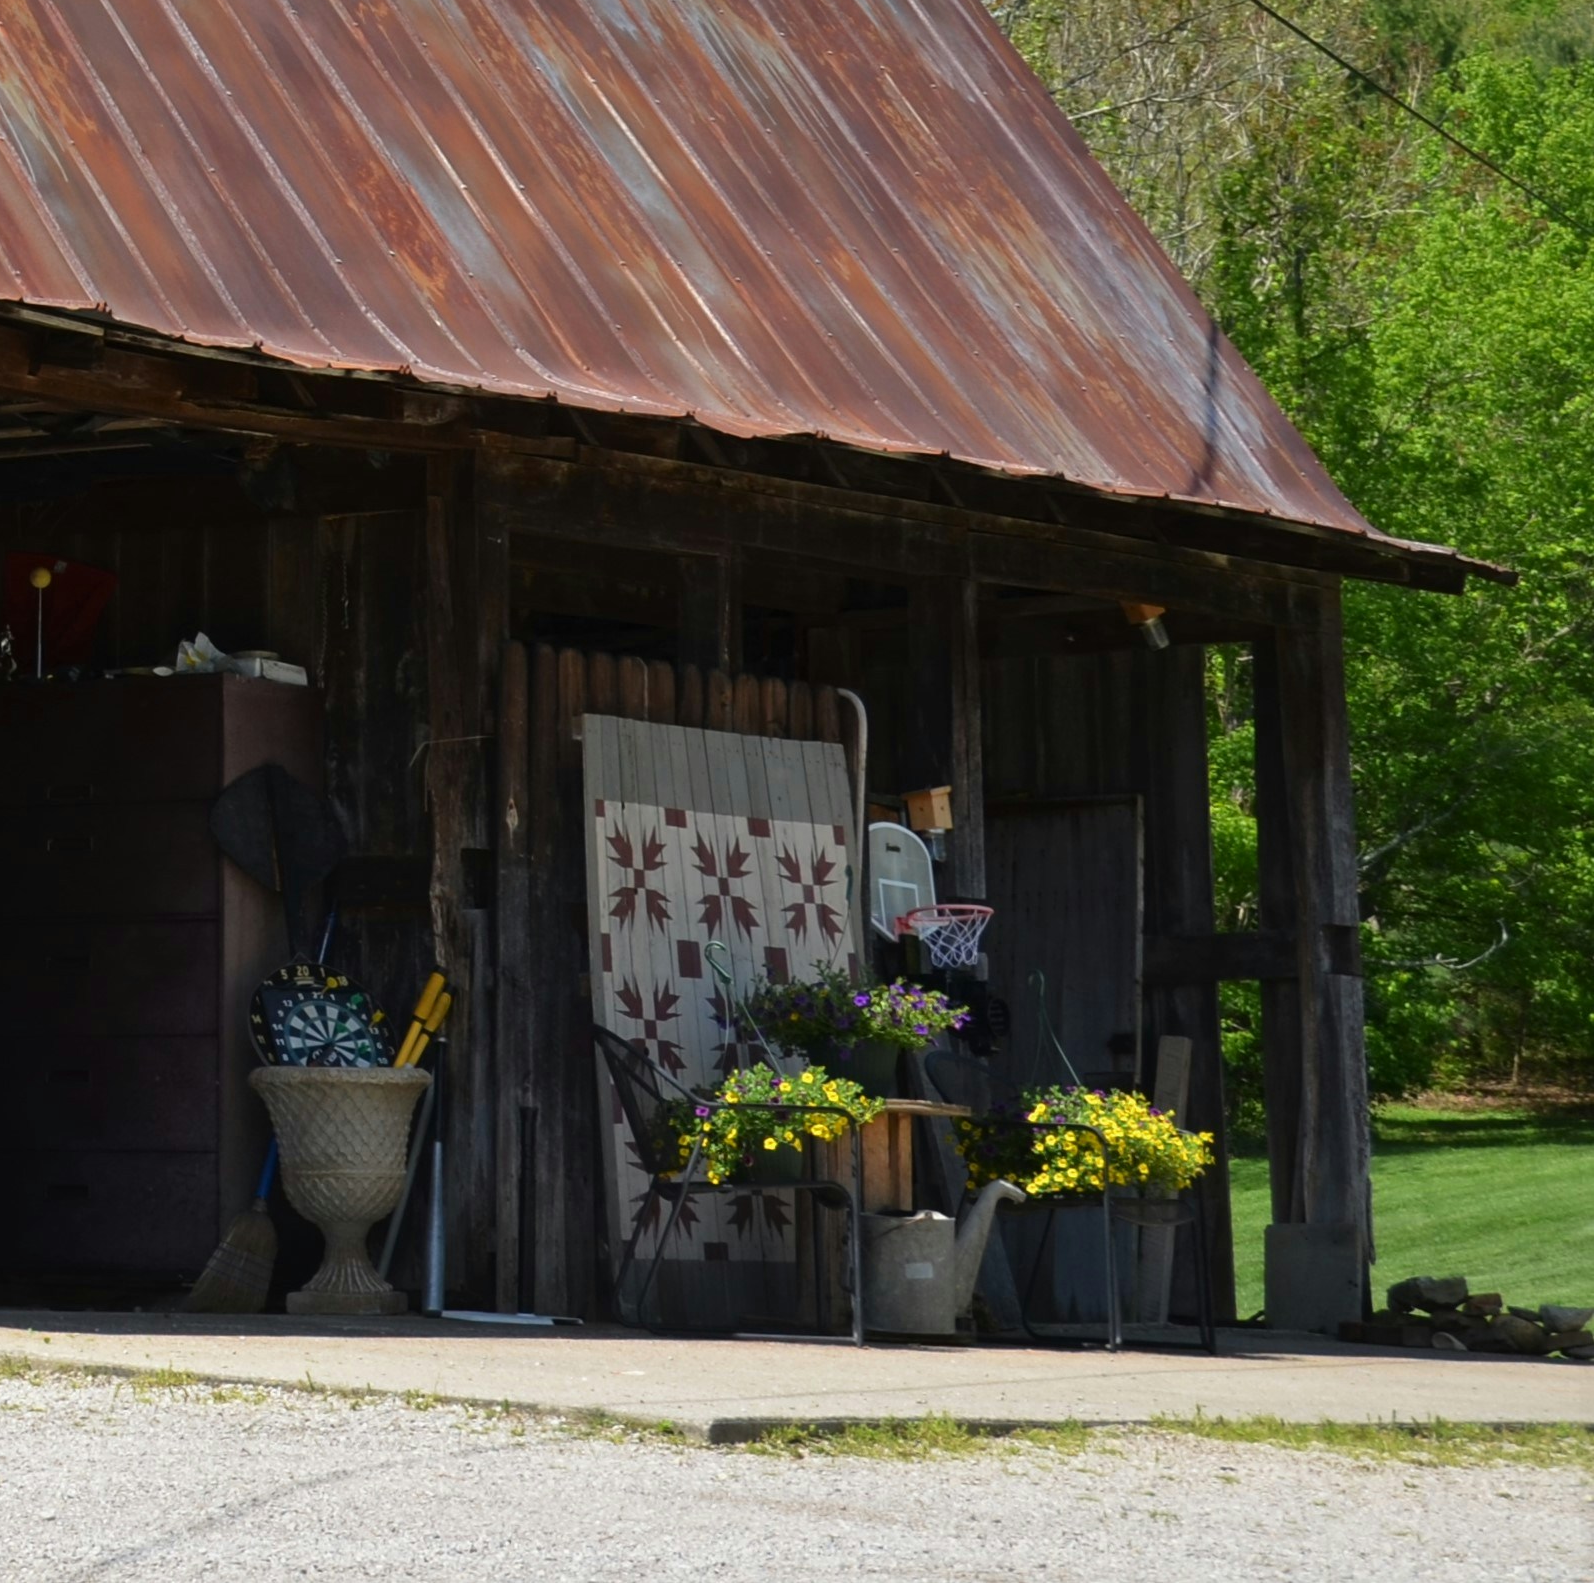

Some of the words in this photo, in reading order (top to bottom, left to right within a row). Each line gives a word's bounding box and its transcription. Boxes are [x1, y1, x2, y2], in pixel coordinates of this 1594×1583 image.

[280, 969, 288, 980] 5
[296, 965, 310, 977] 20
[320, 968, 326, 978] 1
[283, 999, 293, 1007] 12
[251, 1014, 262, 1024] 14
[275, 1038, 285, 1046] 11
